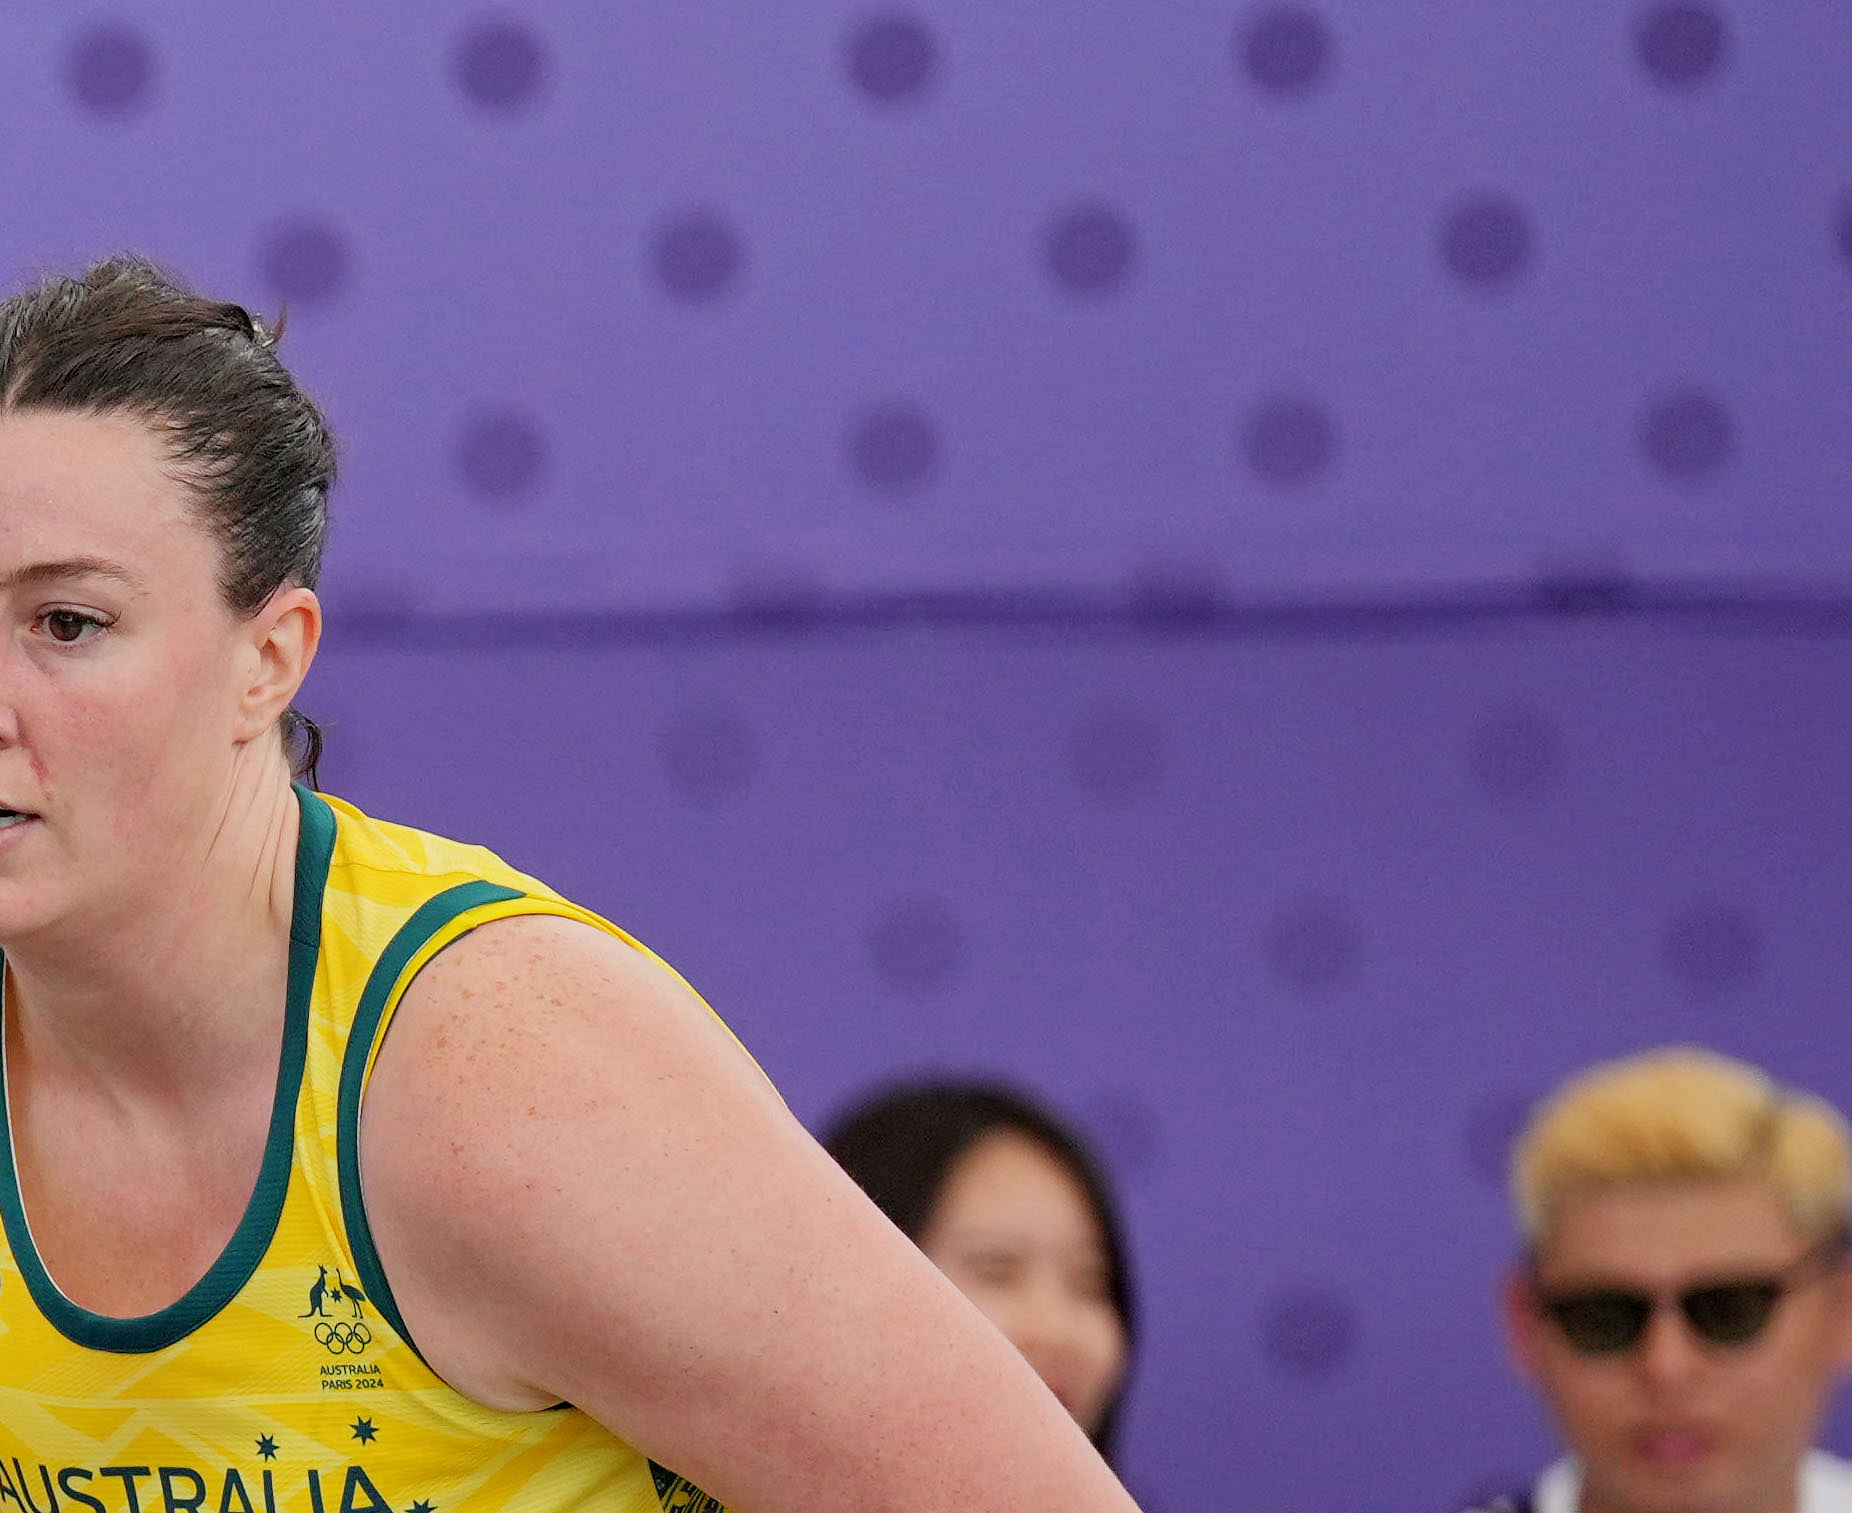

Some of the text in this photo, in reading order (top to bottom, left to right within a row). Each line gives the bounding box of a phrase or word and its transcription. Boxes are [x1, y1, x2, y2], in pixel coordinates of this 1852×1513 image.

[319, 1363, 382, 1376] AUSTRALIA
[321, 1378, 384, 1390] PARIS 2024
